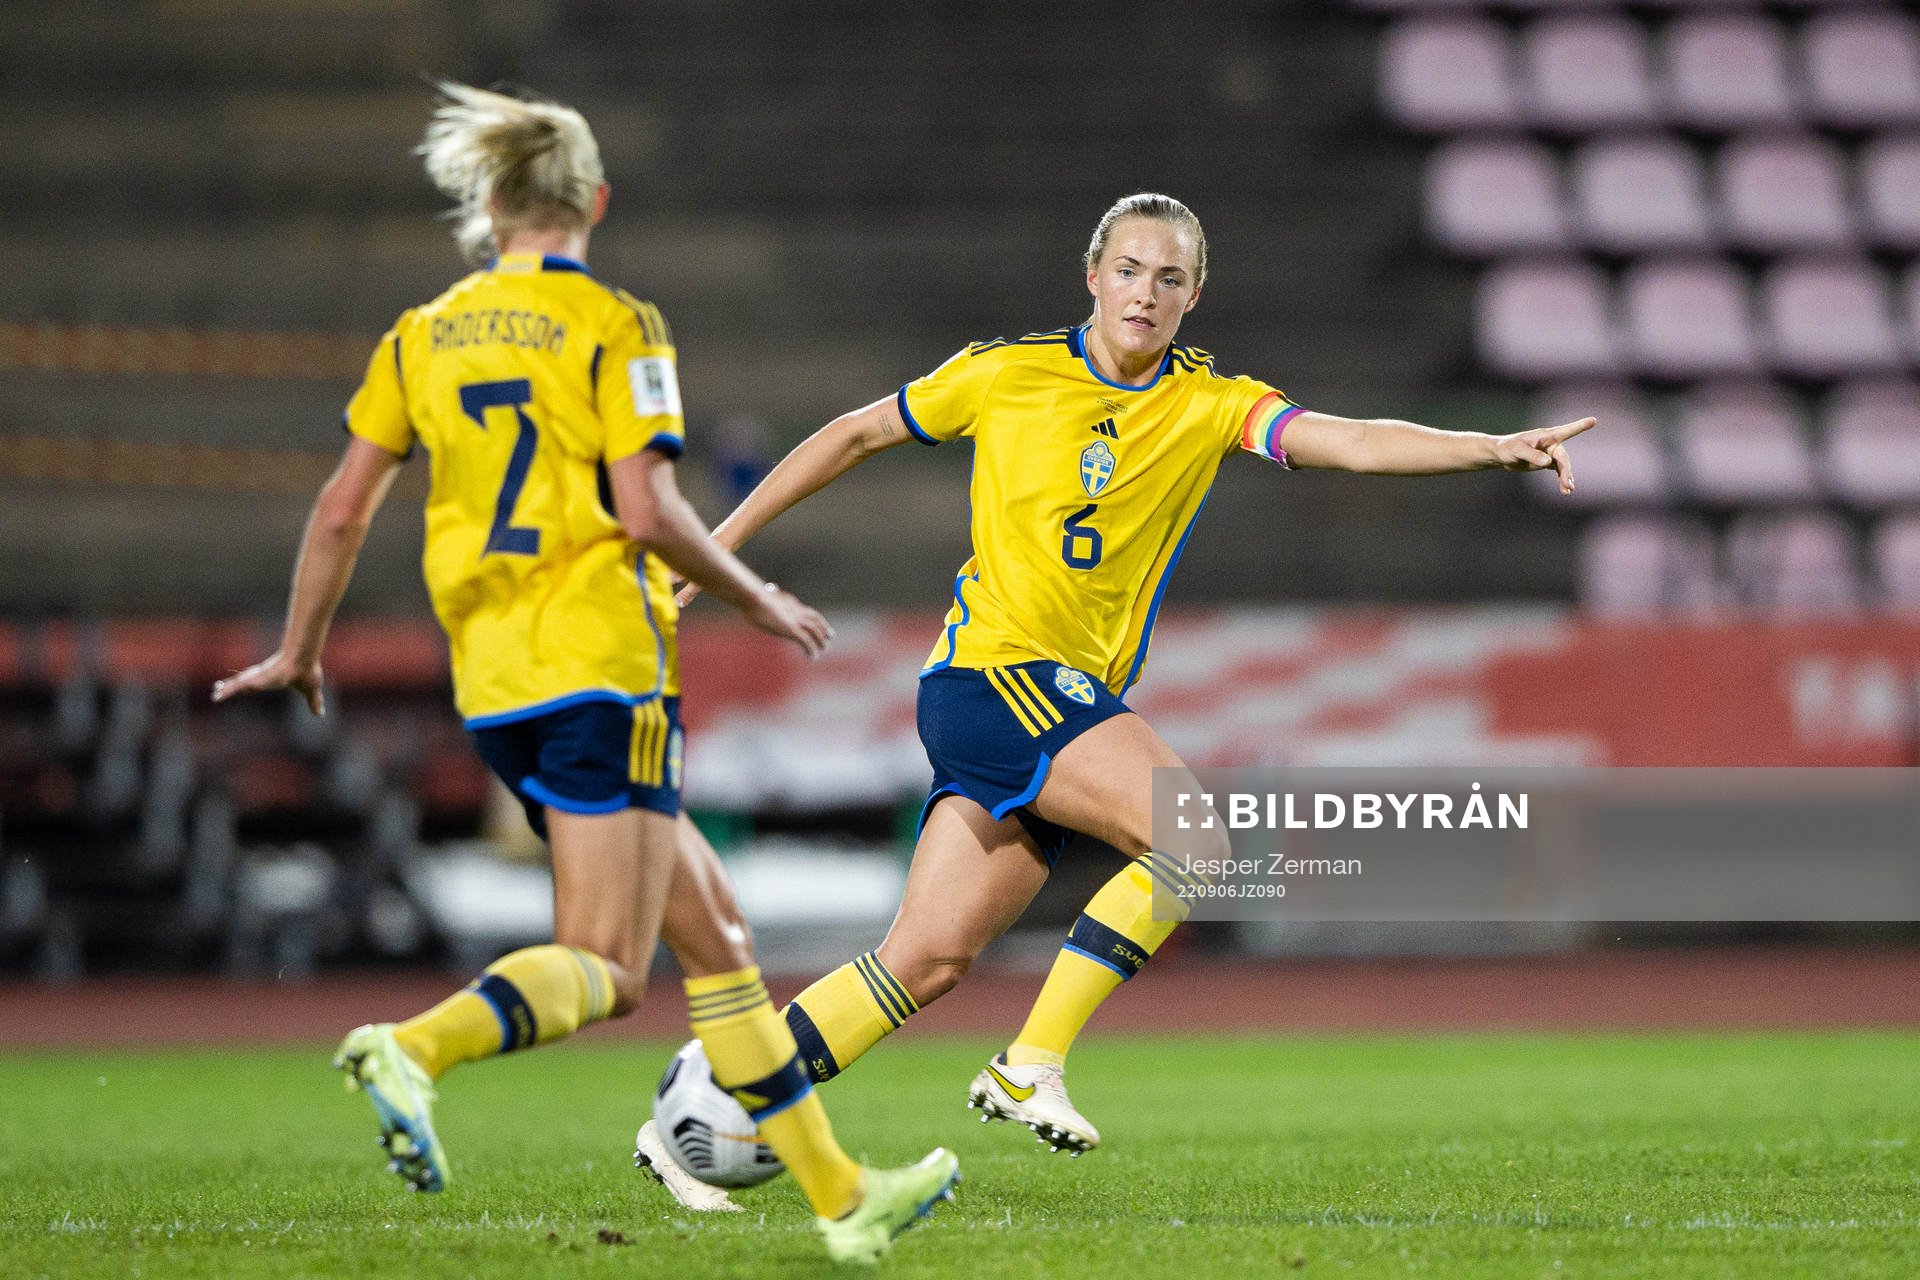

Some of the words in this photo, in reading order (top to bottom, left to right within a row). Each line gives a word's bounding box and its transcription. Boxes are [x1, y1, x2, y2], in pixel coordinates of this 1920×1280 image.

[431, 309, 566, 356] ANDERSSON
[459, 378, 541, 560] 2
[1061, 503, 1103, 571] 6
